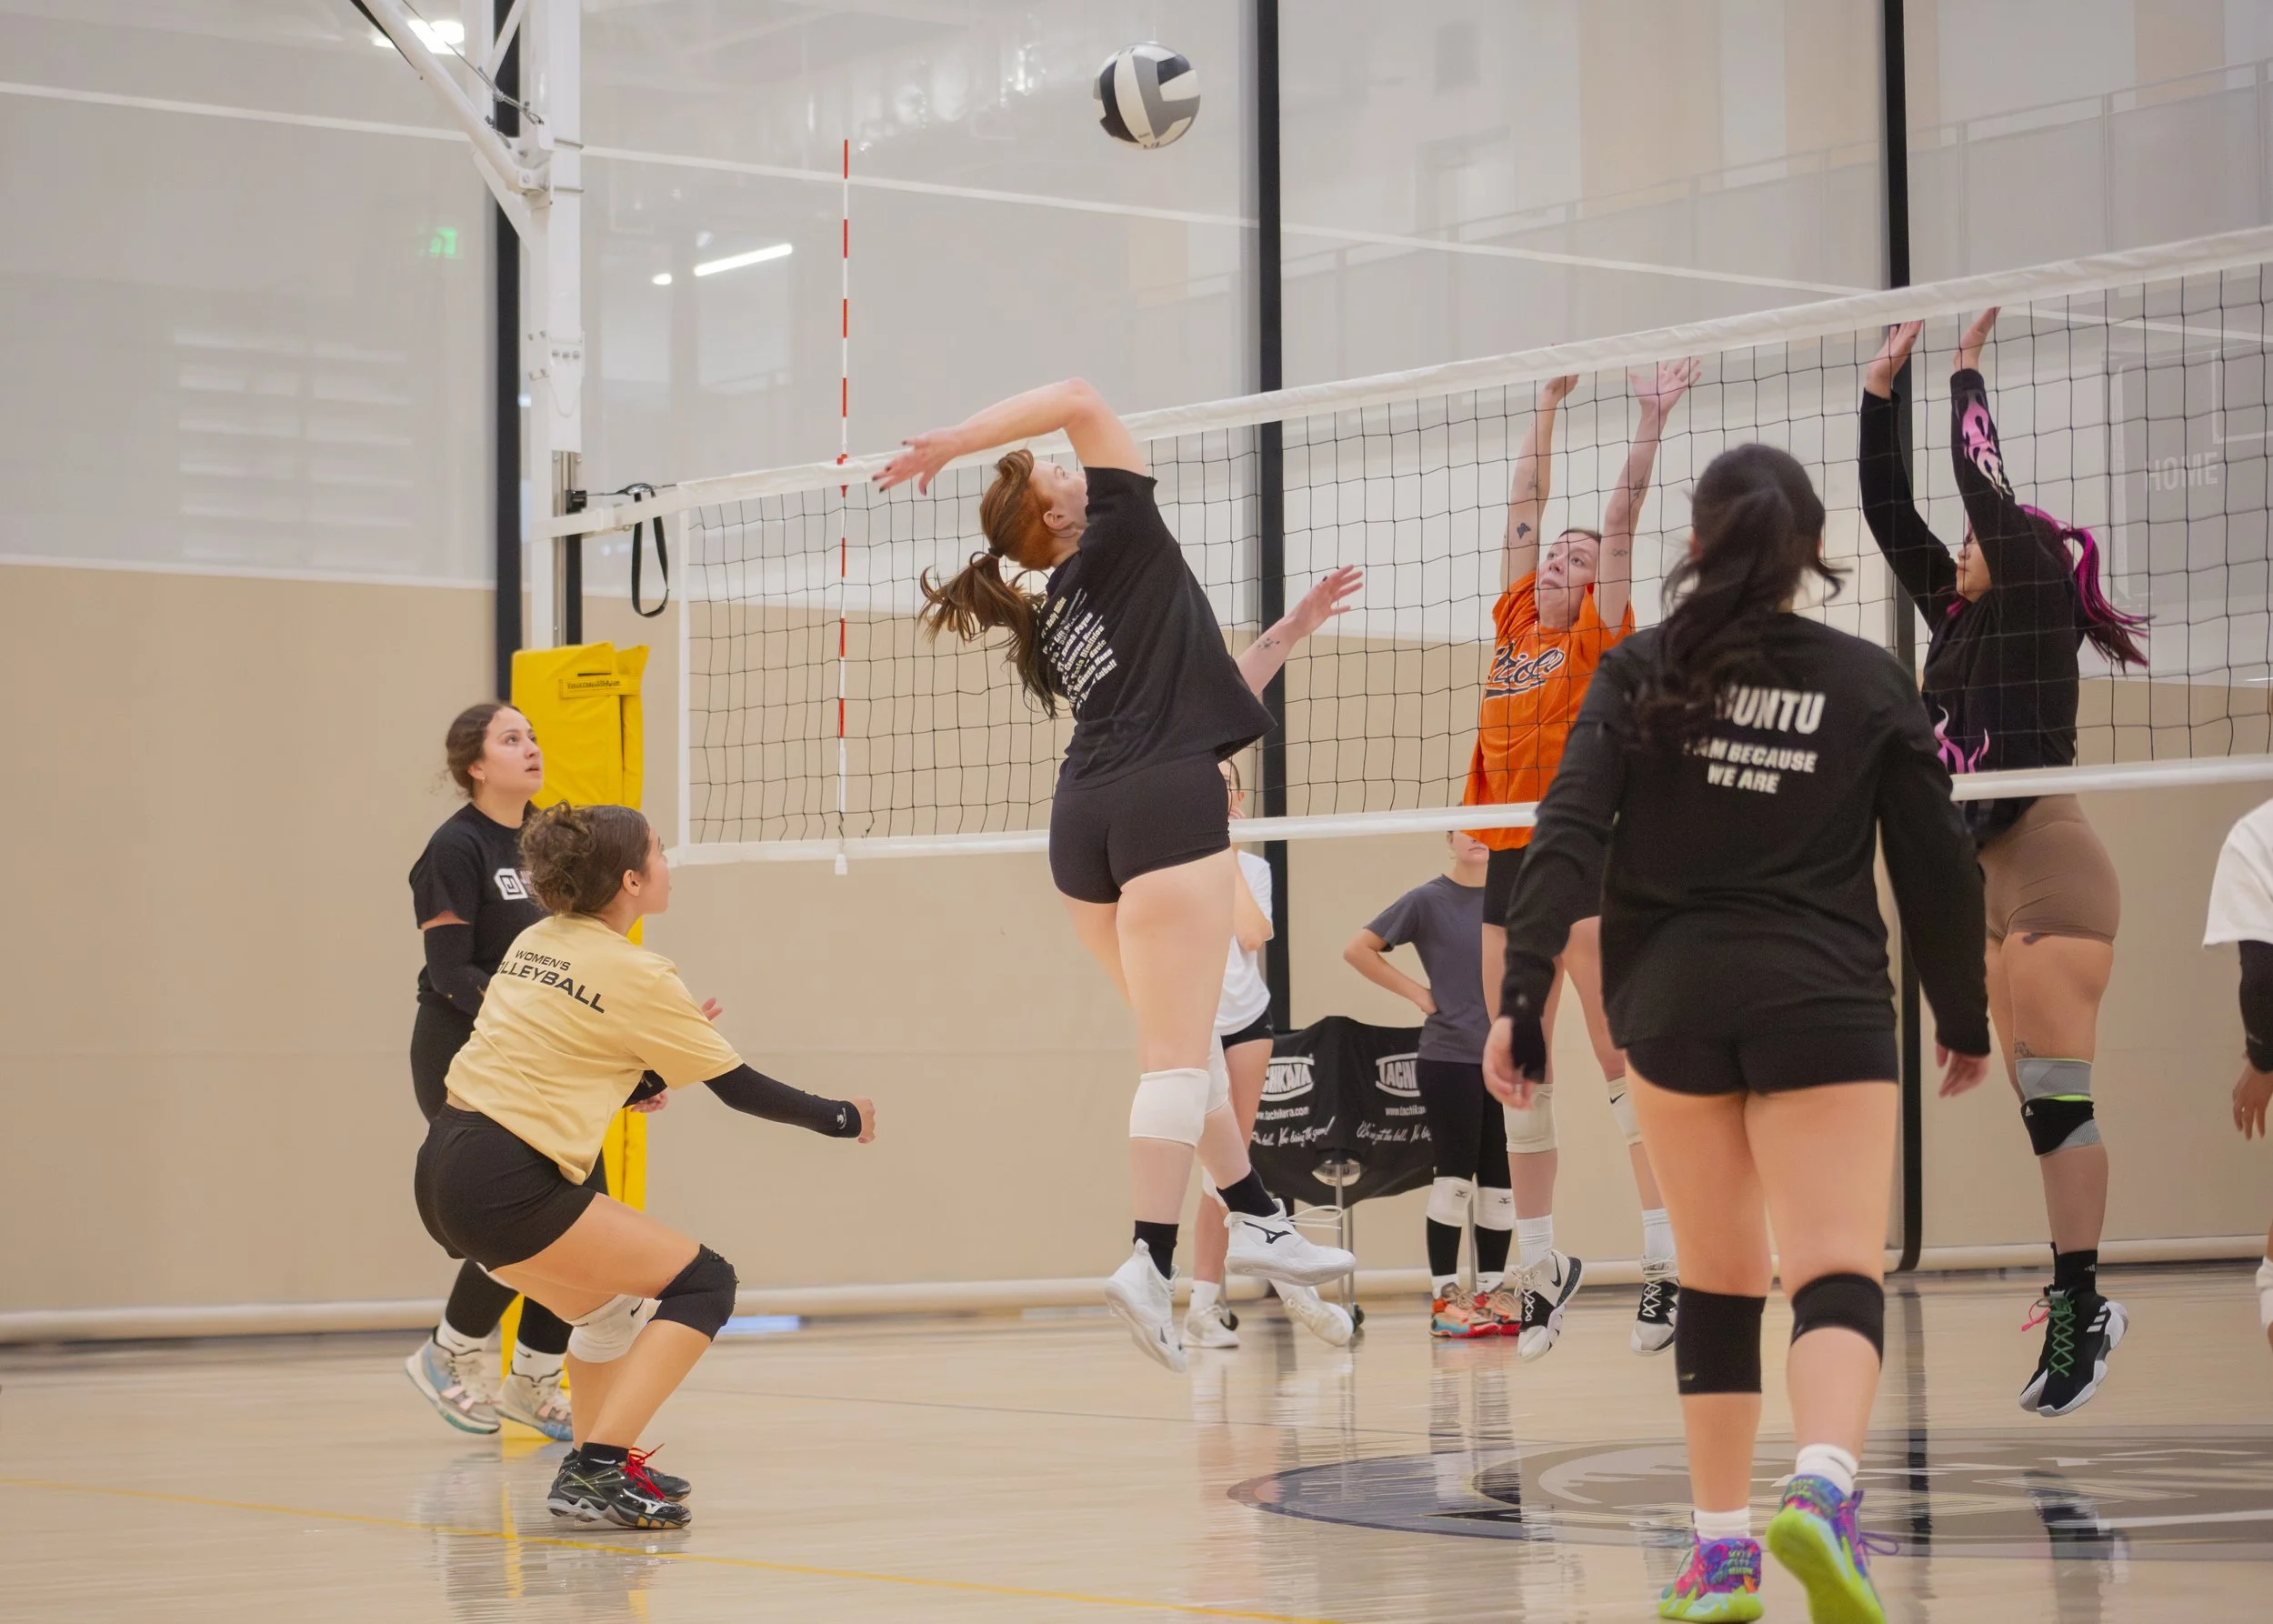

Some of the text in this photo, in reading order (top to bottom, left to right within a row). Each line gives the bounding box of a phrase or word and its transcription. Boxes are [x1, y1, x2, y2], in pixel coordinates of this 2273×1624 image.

[2146, 452, 2219, 491] HOME
[1074, 611, 1094, 635] Payne
[1727, 742, 1818, 774] BECAUSE
[1707, 763, 1781, 795] WE ARE
[515, 949, 571, 971] WOMEN'S
